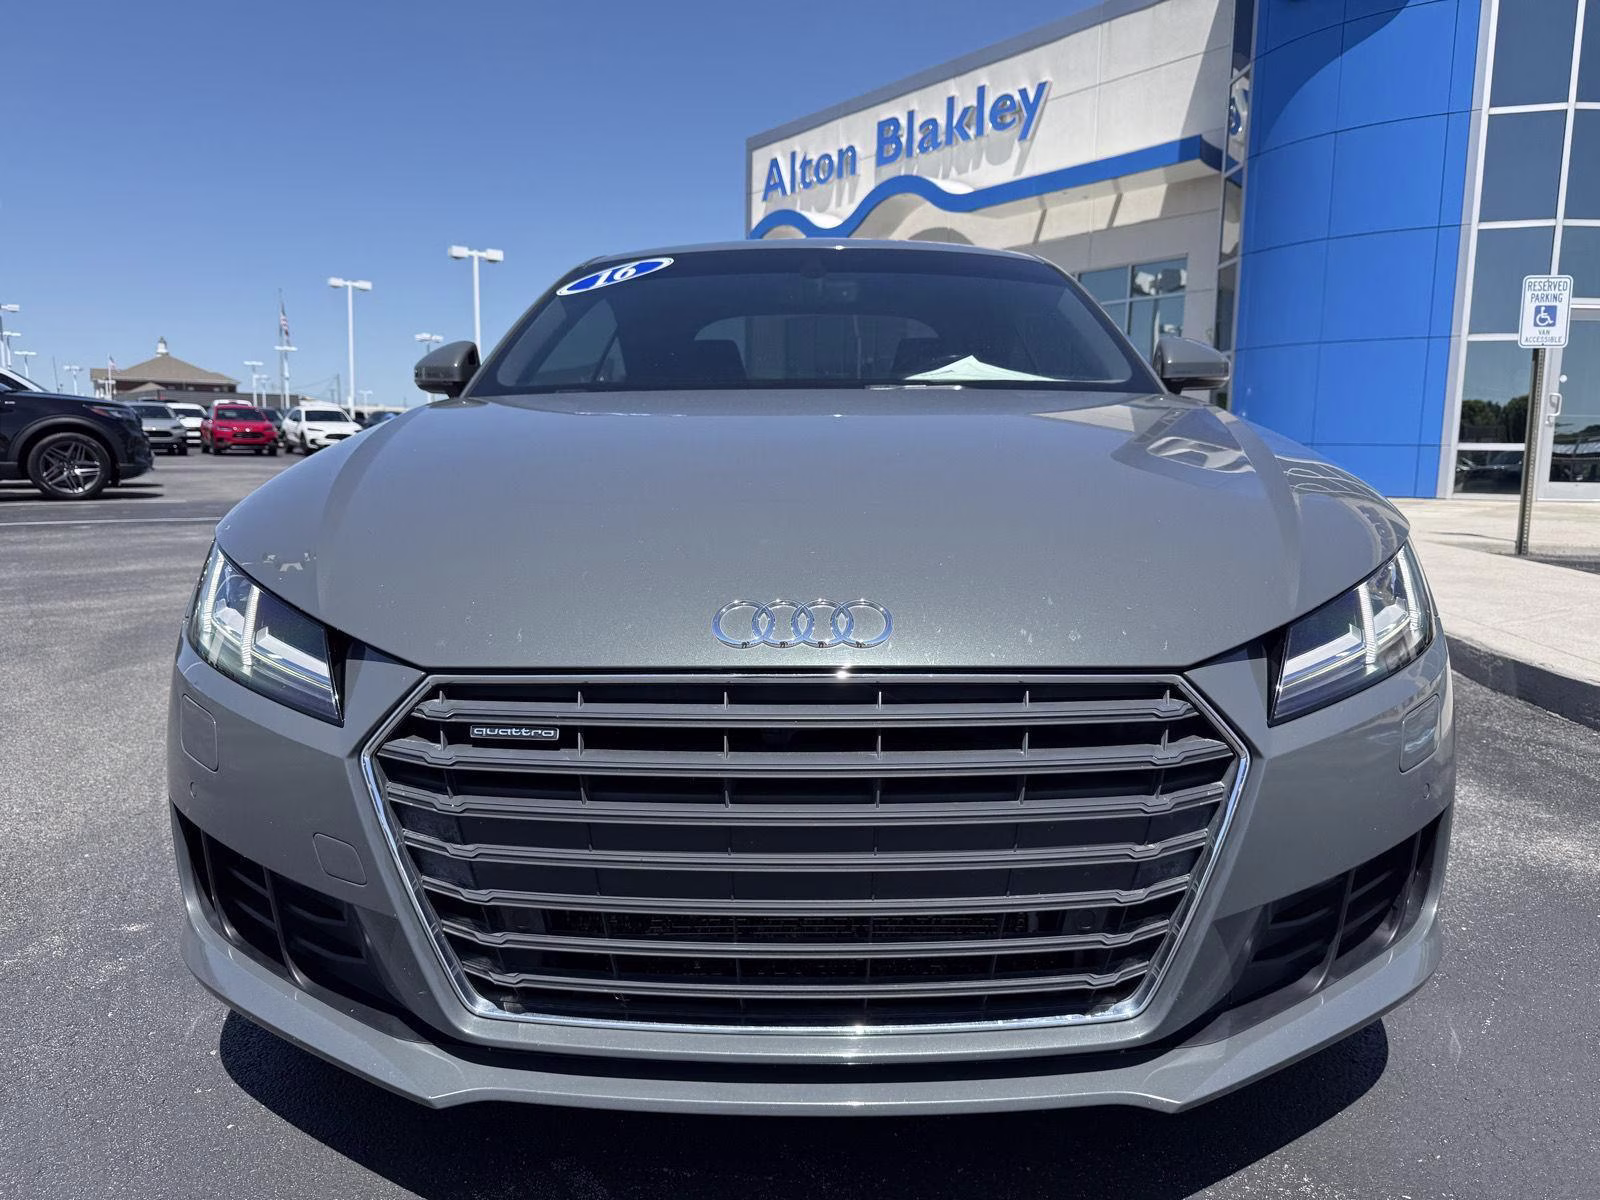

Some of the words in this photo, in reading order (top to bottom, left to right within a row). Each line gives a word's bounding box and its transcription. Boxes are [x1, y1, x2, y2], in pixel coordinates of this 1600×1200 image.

[762, 143, 857, 202] Alton
[875, 80, 1049, 168] Blakley
[592, 263, 637, 288] 16
[1527, 280, 1568, 292] RESERVED
[1530, 293, 1563, 303] PARKING
[473, 727, 555, 737] quattro
